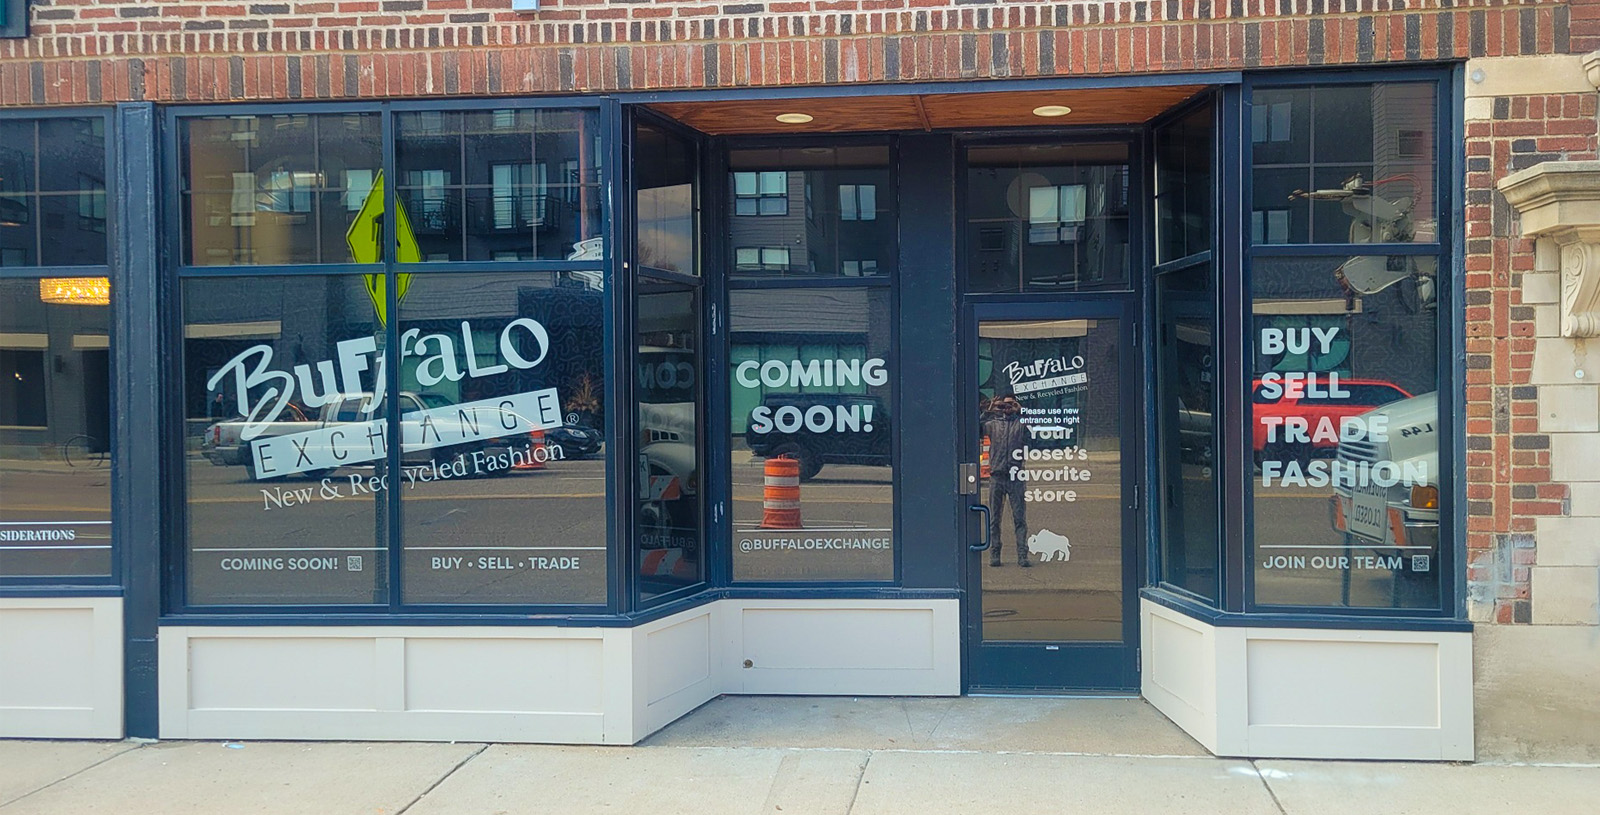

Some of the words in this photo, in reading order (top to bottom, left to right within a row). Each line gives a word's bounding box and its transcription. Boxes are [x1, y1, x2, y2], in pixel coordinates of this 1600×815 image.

[1261, 327, 1339, 355] BUY
[736, 358, 888, 388] COMING
[1014, 374, 1086, 393] EXCHANGE
[1037, 388, 1064, 399] Recycled
[1064, 384, 1088, 394] Fashion
[1261, 372, 1350, 399] SELL
[751, 404, 874, 434] SOON!
[1020, 407, 1046, 415] Please
[1020, 416, 1052, 424] entrance
[1054, 416, 1062, 424] to
[1063, 416, 1080, 426] right
[257, 393, 556, 474] EXCHANGE
[1261, 416, 1389, 443] TRADE
[260, 486, 314, 511] New
[319, 477, 344, 501] &
[470, 442, 567, 474] Fashion
[1009, 465, 1092, 481] favorite
[1262, 460, 1428, 488] FASHION
[1023, 488, 1077, 502] store
[0, 530, 75, 541] SIDERATIONS
[739, 538, 890, 553] @BUFFALOEXCHANGE
[220, 558, 284, 571] COMING
[288, 557, 338, 570] SOON!
[431, 557, 463, 569] BUY
[478, 557, 514, 569] SELL
[528, 557, 580, 569] TRADE
[1263, 556, 1305, 569] JOIN
[1311, 556, 1349, 569] OUR
[1354, 556, 1403, 569] TEAM
